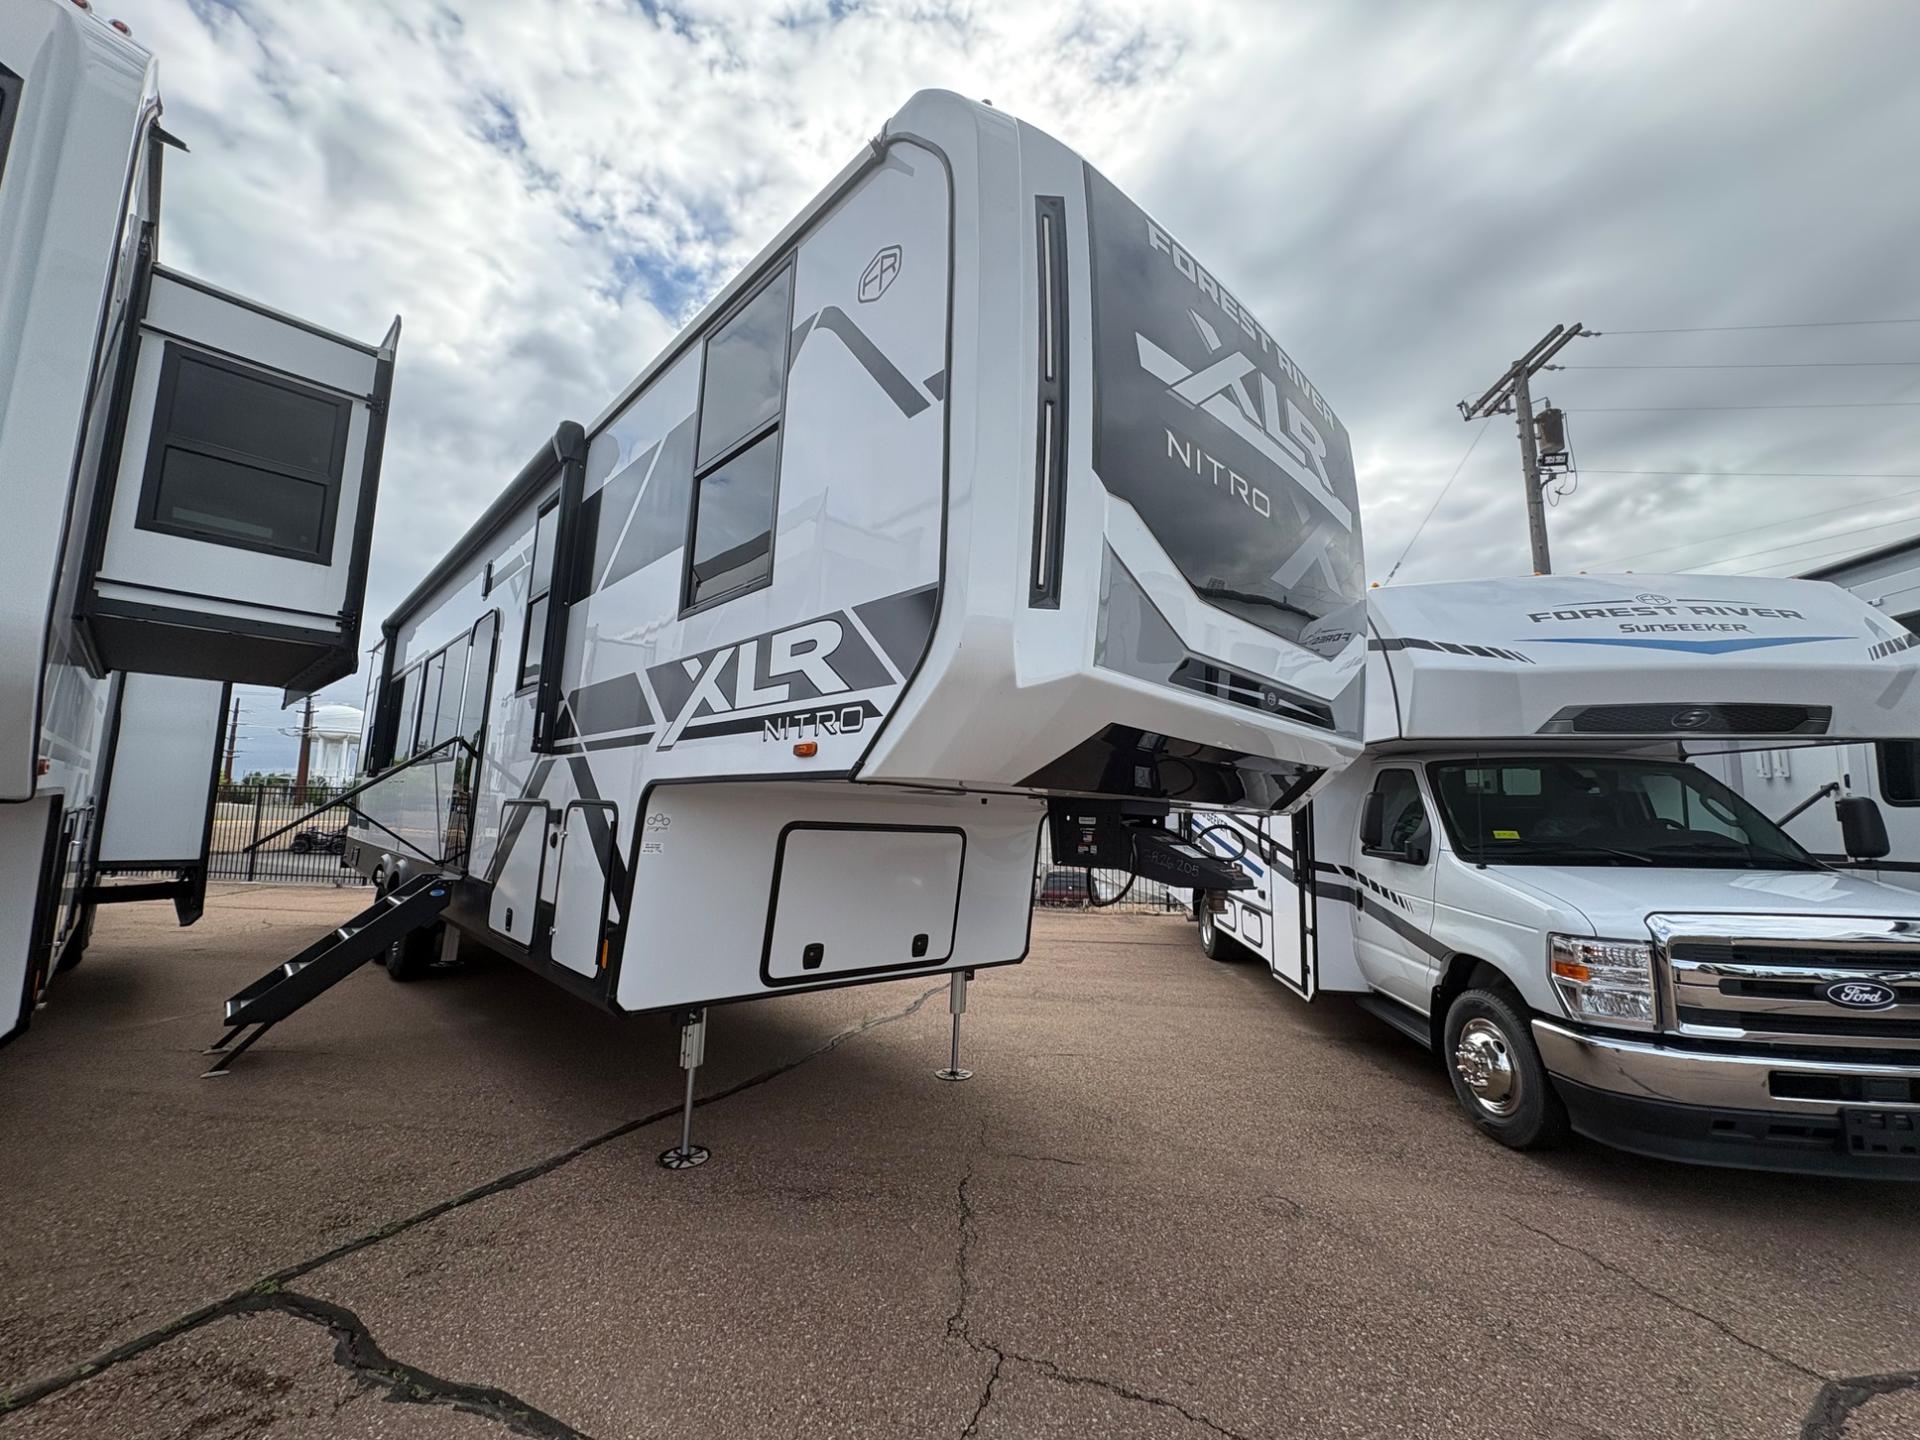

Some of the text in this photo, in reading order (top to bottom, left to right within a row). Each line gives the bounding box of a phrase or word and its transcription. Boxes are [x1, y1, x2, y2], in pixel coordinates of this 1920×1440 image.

[1145, 219, 1335, 431] FOREST RIVER
[1171, 309, 1336, 497] XLR
[1165, 428, 1271, 518] NITRO
[1526, 605, 1807, 623] FOREST RIVER
[657, 617, 852, 752] XLR
[763, 705, 865, 742] NITRO
[1177, 858, 1200, 877] 205
[1841, 985, 1882, 1003] Ford
